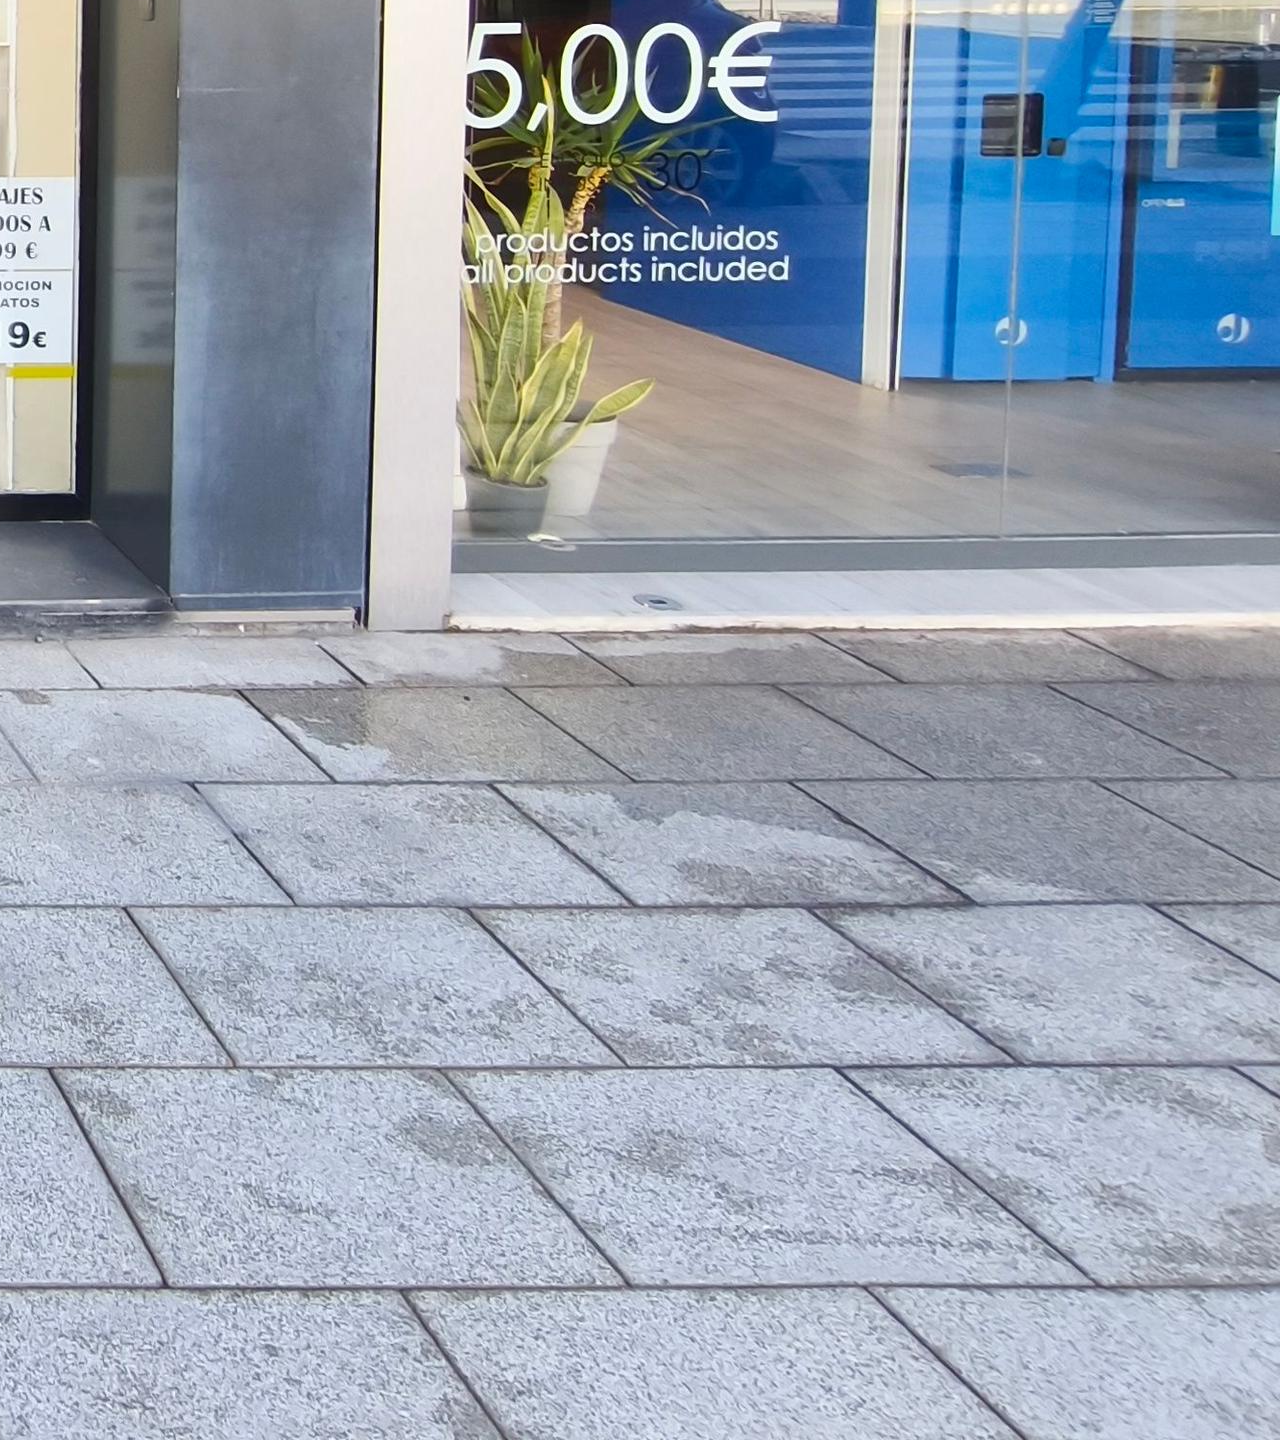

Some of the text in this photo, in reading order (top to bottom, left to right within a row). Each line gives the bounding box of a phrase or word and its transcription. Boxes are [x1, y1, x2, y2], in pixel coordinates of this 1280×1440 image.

[464, 20, 782, 132] 5,00€
[38, 215, 52, 233] A
[476, 224, 779, 260] productos incluidos
[26, 241, 38, 260] €
[461, 254, 789, 291] all products included
